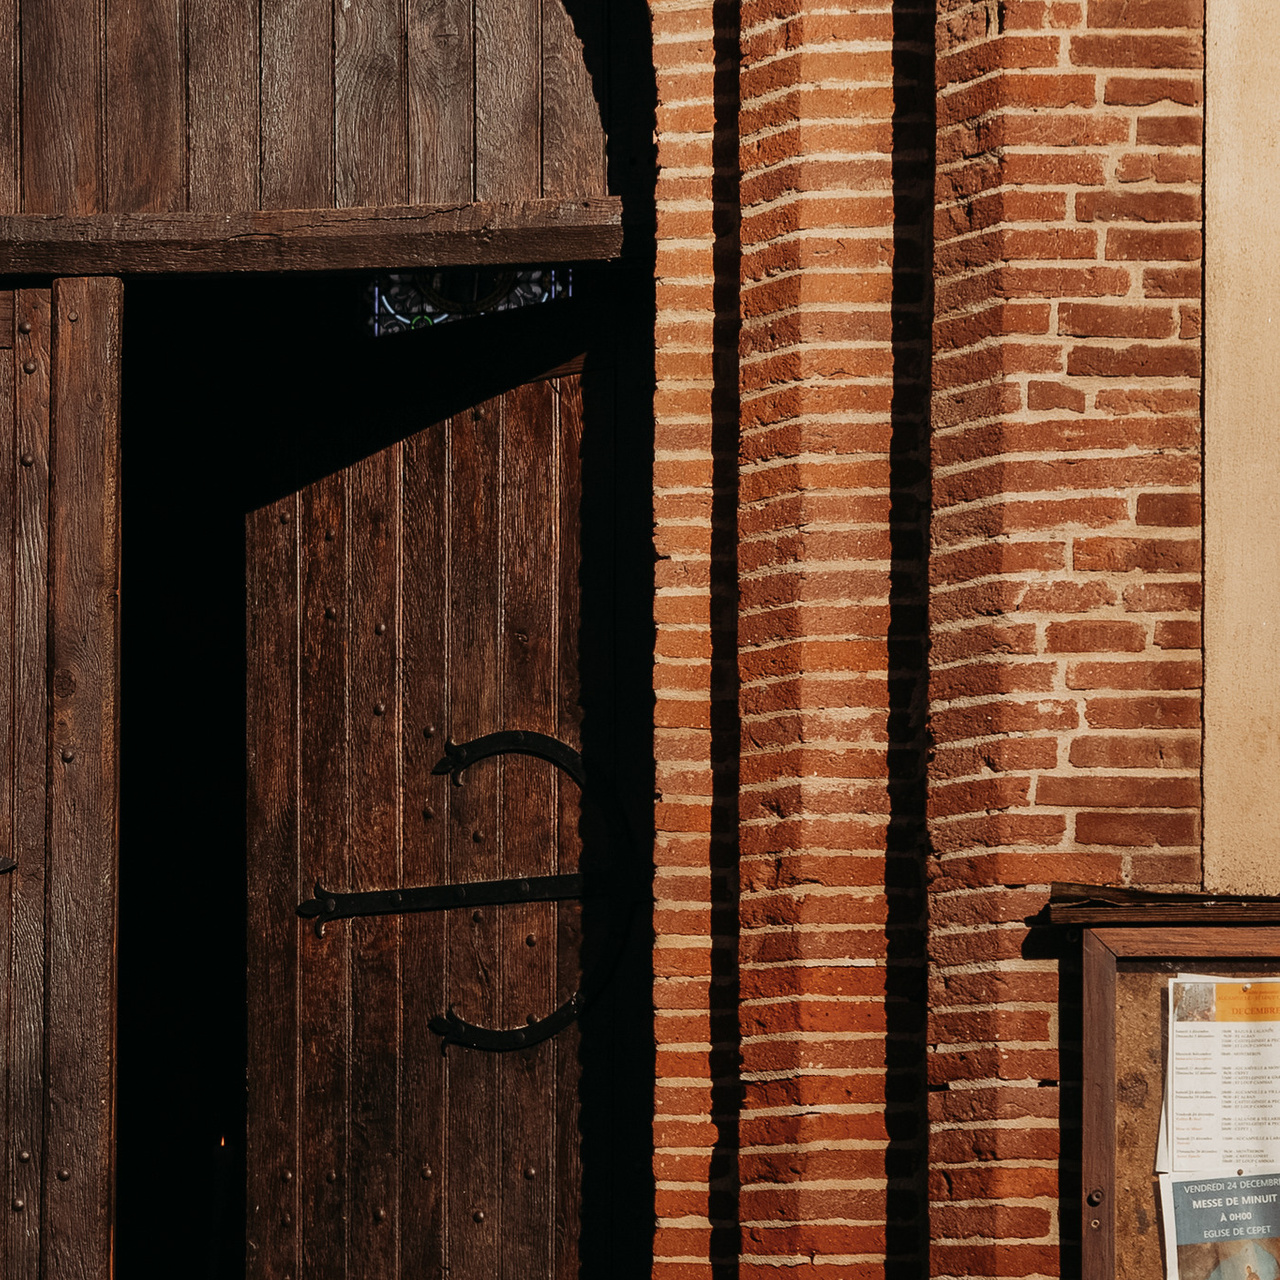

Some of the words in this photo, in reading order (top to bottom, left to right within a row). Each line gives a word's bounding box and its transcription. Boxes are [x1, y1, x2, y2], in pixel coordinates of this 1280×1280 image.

[1184, 1183, 1225, 1194] VENDREDI
[1227, 1182, 1237, 1190] 24
[1192, 1198, 1223, 1209] MESSE
[1226, 1197, 1239, 1206] DE
[1241, 1194, 1278, 1205] MINUIT
[1220, 1212, 1227, 1222] À
[1204, 1228, 1230, 1238] EGLISE
[1233, 1227, 1245, 1236] DE
[1246, 1225, 1271, 1235] CEPET
